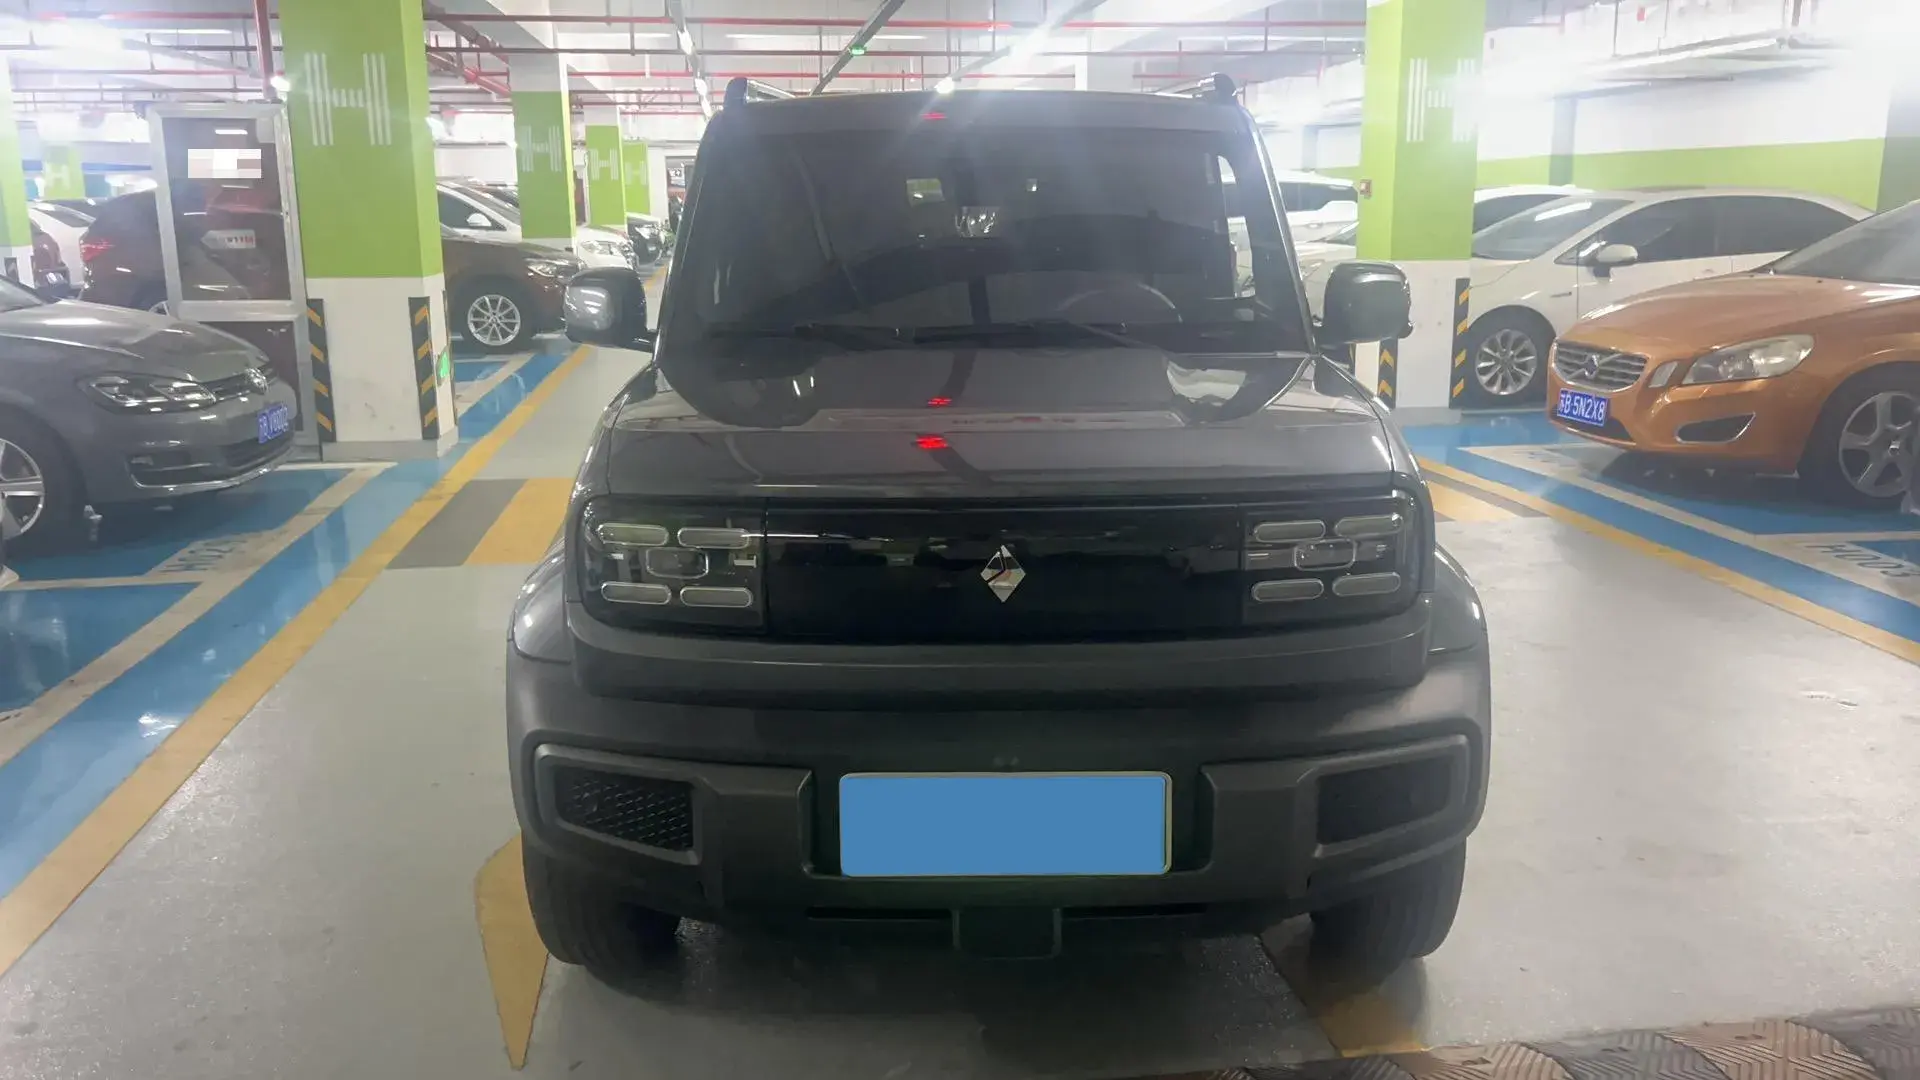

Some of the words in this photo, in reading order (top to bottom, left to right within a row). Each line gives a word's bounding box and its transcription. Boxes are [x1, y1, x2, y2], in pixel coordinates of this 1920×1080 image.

[304, 52, 392, 146] H
[1405, 57, 1476, 142] H
[519, 125, 562, 173] H
[589, 148, 619, 180] H
[625, 160, 648, 185] H
